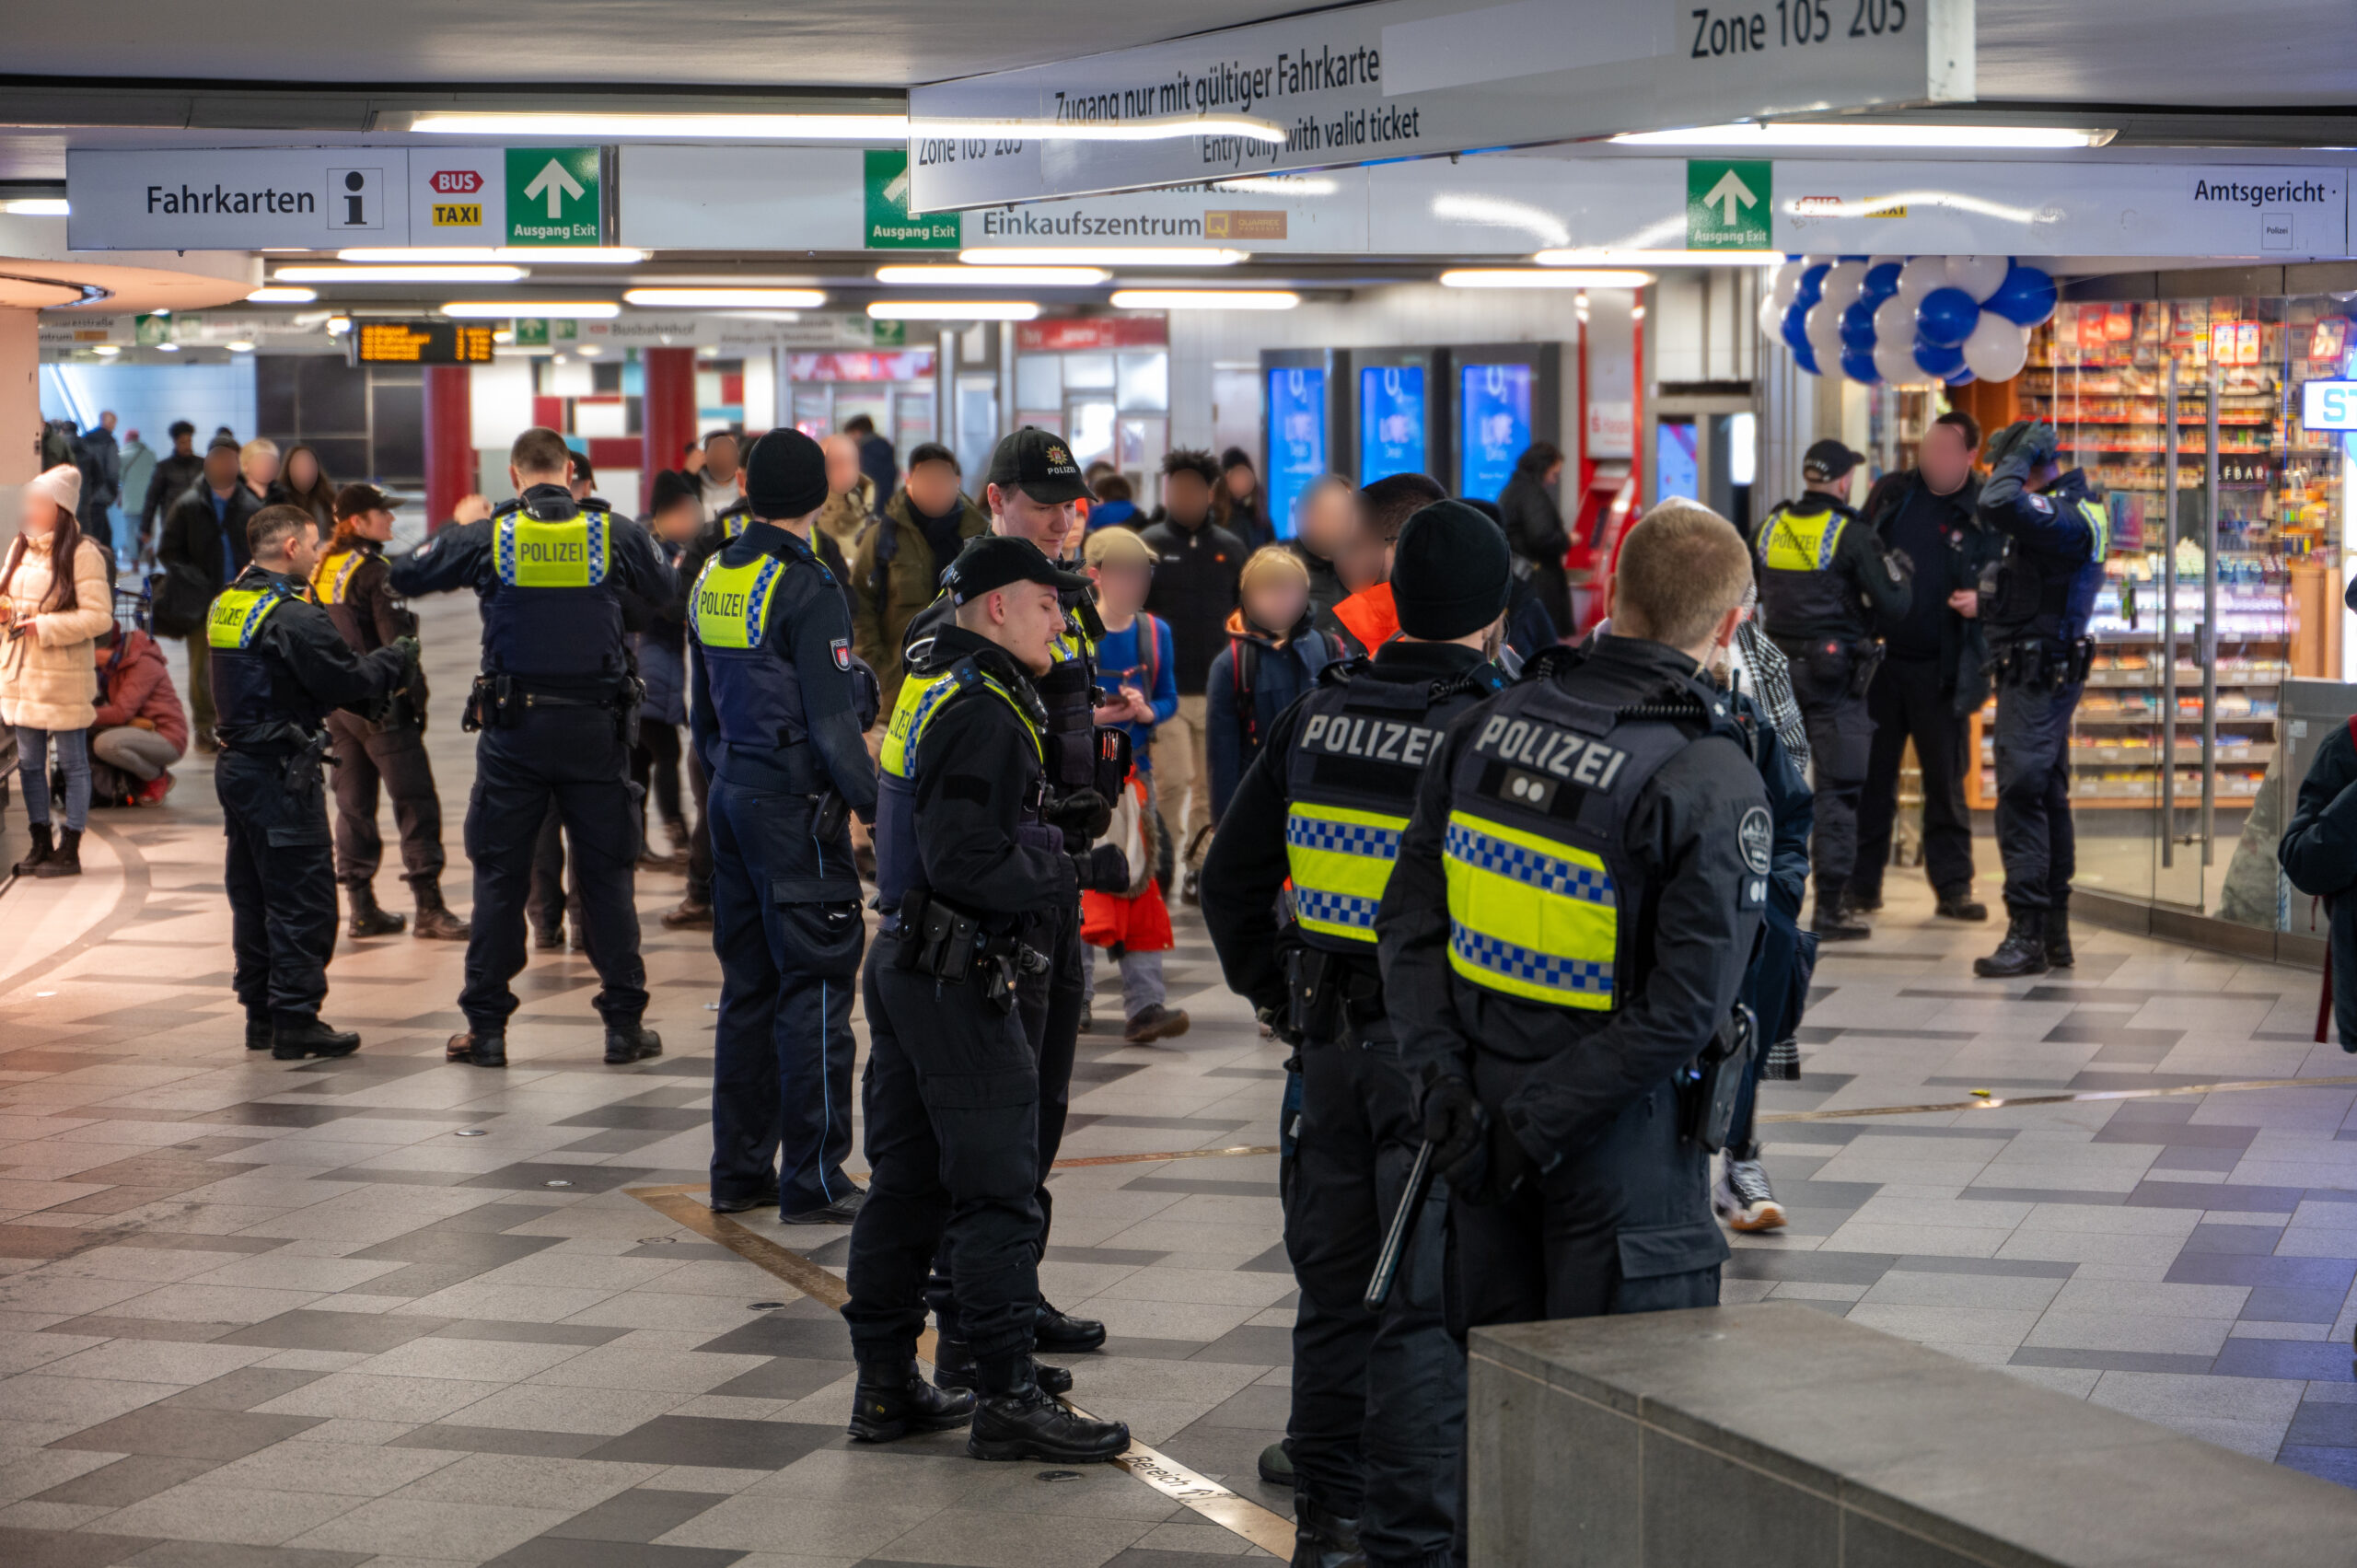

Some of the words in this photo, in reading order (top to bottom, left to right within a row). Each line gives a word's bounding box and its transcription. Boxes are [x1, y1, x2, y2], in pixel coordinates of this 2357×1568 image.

[1692, 8, 1766, 58] Zone
[1776, 0, 1830, 46] 105
[1055, 91, 1120, 126] Zugang
[1124, 85, 1155, 119] nur
[1160, 70, 1190, 113] mit
[1195, 61, 1272, 119] gültiger
[1277, 44, 1380, 96] Fahrkarte
[1202, 134, 1241, 168] Entry
[1284, 115, 1320, 152] with
[1325, 108, 1365, 148] valid
[1370, 104, 1420, 143] ticket
[438, 173, 475, 191] BUS
[147, 184, 315, 214] Fahrkarten
[2194, 180, 2326, 207] Amtsgericht
[435, 206, 479, 223] TAXI
[983, 211, 1202, 237] Einkaufszentrum
[514, 224, 570, 239] Ausgang
[573, 224, 597, 237] Exit
[873, 225, 930, 240] Ausgang
[933, 225, 956, 238] Exit
[1693, 230, 1744, 244] Ausgang
[1746, 230, 1767, 242] Exit
[2266, 226, 2289, 235] Polizei
[1047, 466, 1076, 476] POLIZEI
[2217, 465, 2264, 480] FBAR
[520, 542, 584, 563] POLIZEI
[1771, 533, 1818, 552] POLIZEI
[700, 590, 745, 618] POLIZEI
[1475, 714, 1626, 789] POLIZEI
[1121, 1456, 1192, 1487] Bereich
